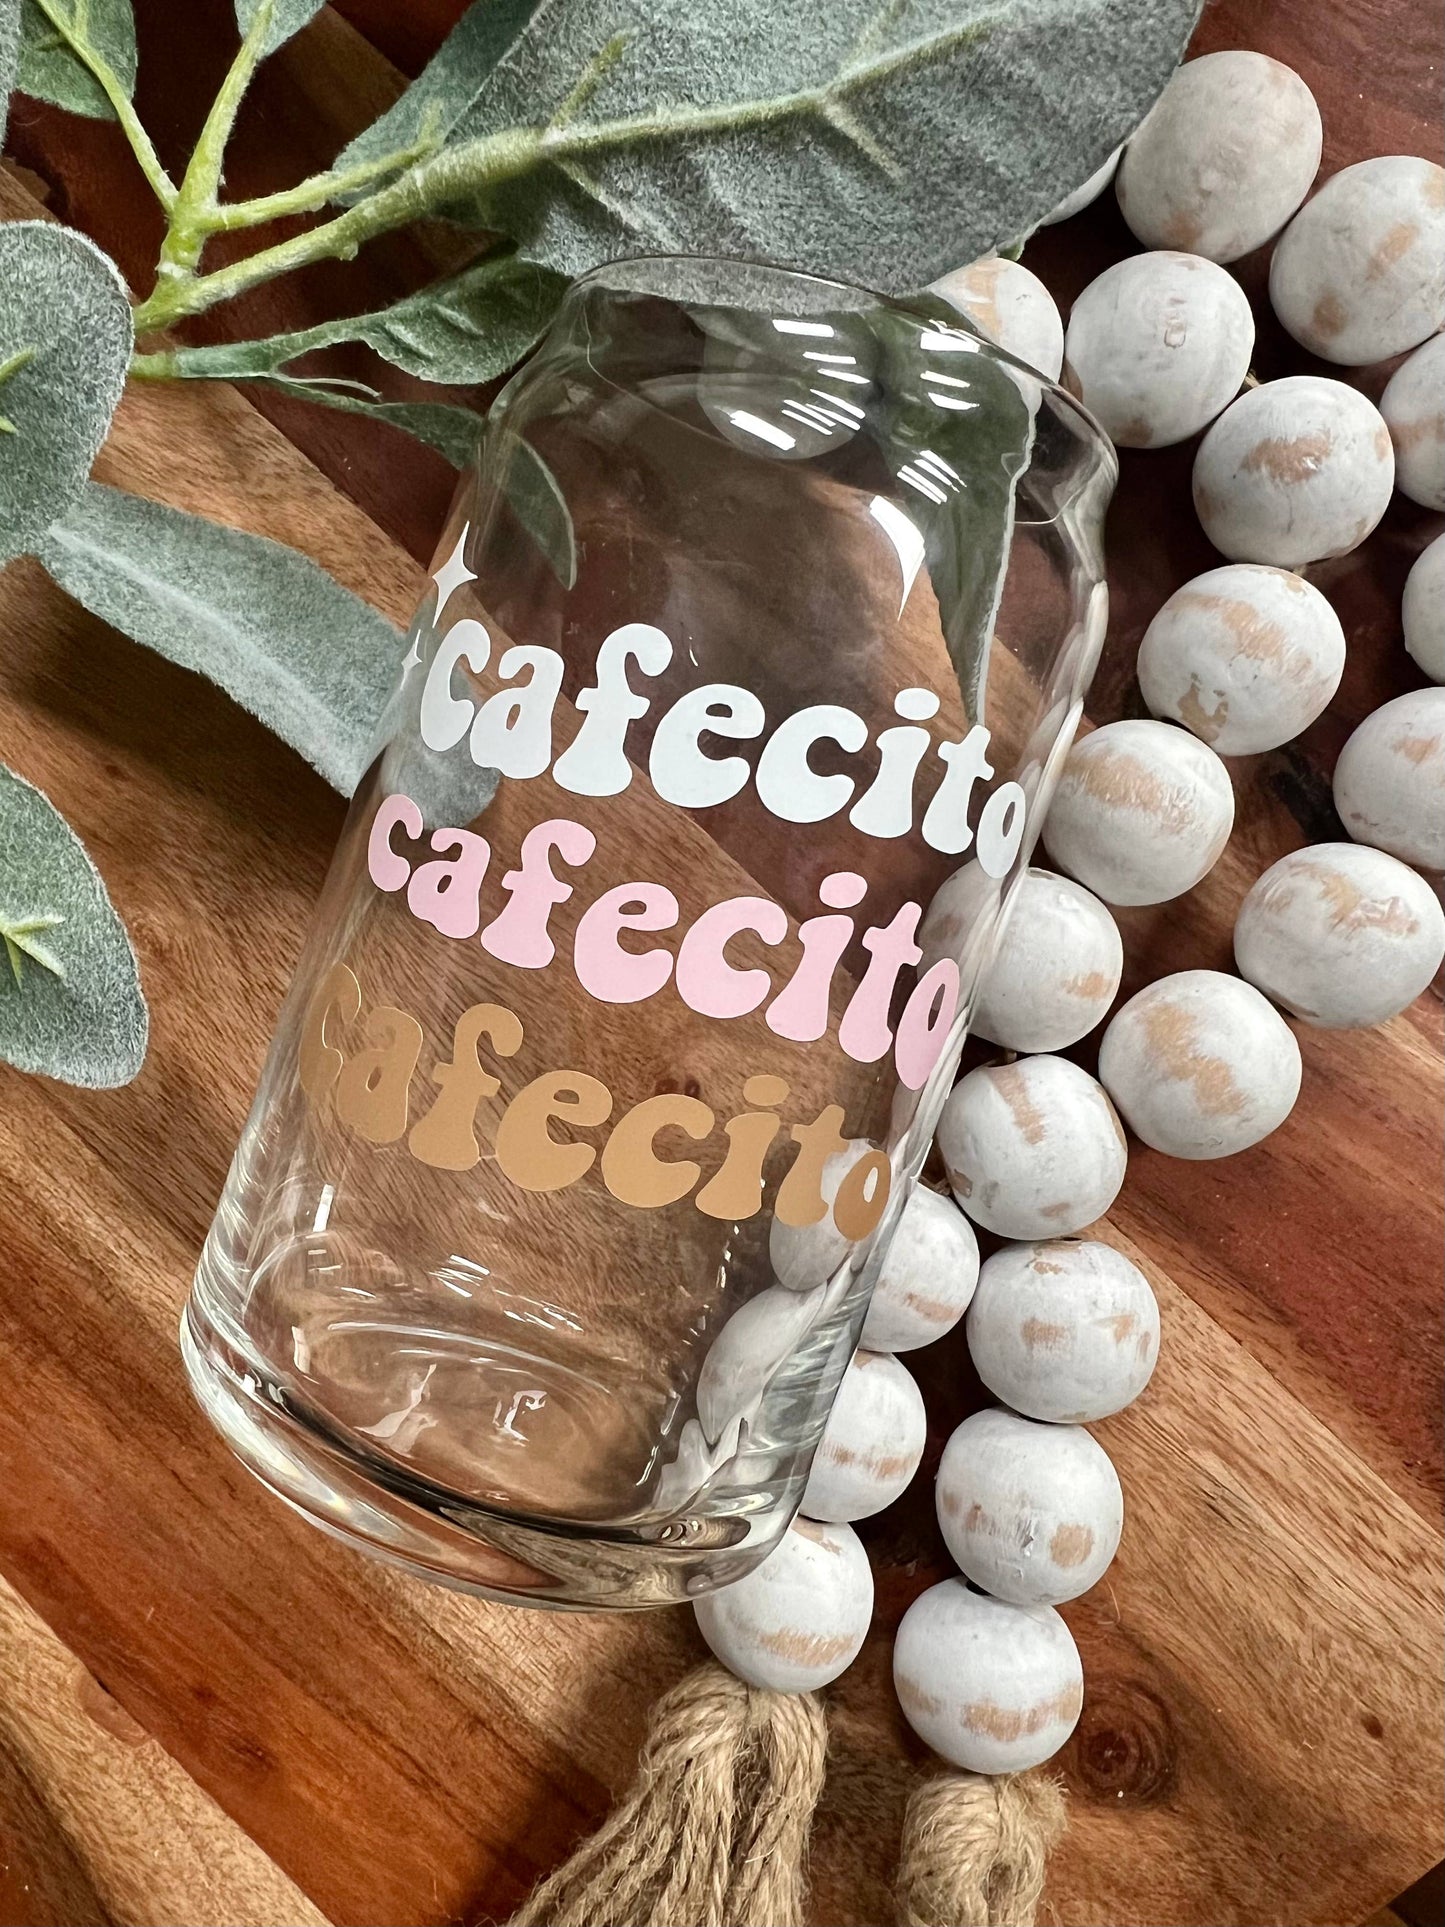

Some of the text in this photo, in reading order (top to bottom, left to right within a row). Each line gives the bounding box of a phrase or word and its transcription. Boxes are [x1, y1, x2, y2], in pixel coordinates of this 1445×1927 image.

[420, 618, 1026, 878] cafecito
[367, 794, 961, 1090] cafecito
[300, 963, 891, 1241] cafecito
